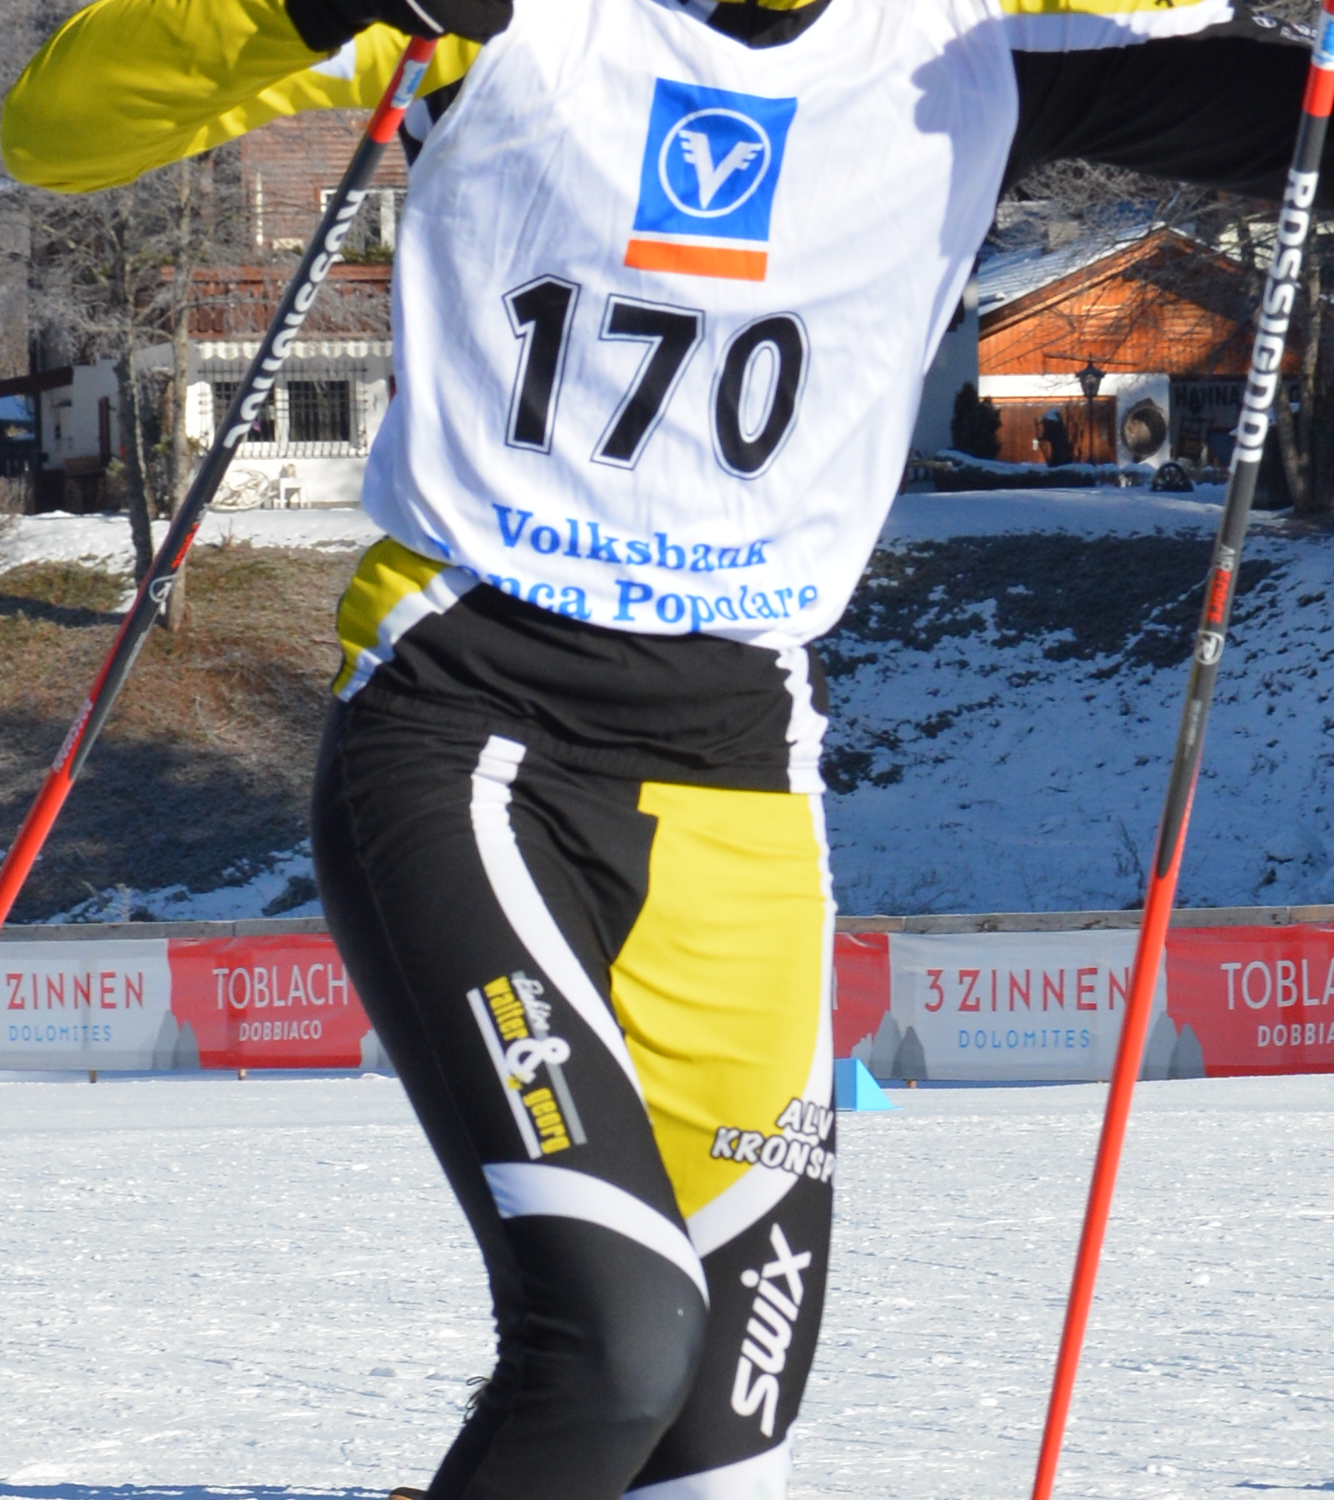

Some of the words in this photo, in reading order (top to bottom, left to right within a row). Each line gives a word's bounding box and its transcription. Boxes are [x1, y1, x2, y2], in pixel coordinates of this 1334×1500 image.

[502, 273, 811, 481] 170
[492, 502, 773, 573] Volksbank
[212, 962, 349, 1010] TOBLACH
[483, 975, 529, 1041] walter
[8, 1024, 113, 1043] DOLOMITES
[238, 1019, 323, 1042] DOBBIACO
[957, 1027, 1091, 1050] DOLOMITES
[506, 1035, 571, 1084] &
[522, 1086, 571, 1155] georg
[775, 1096, 835, 1142] ALV
